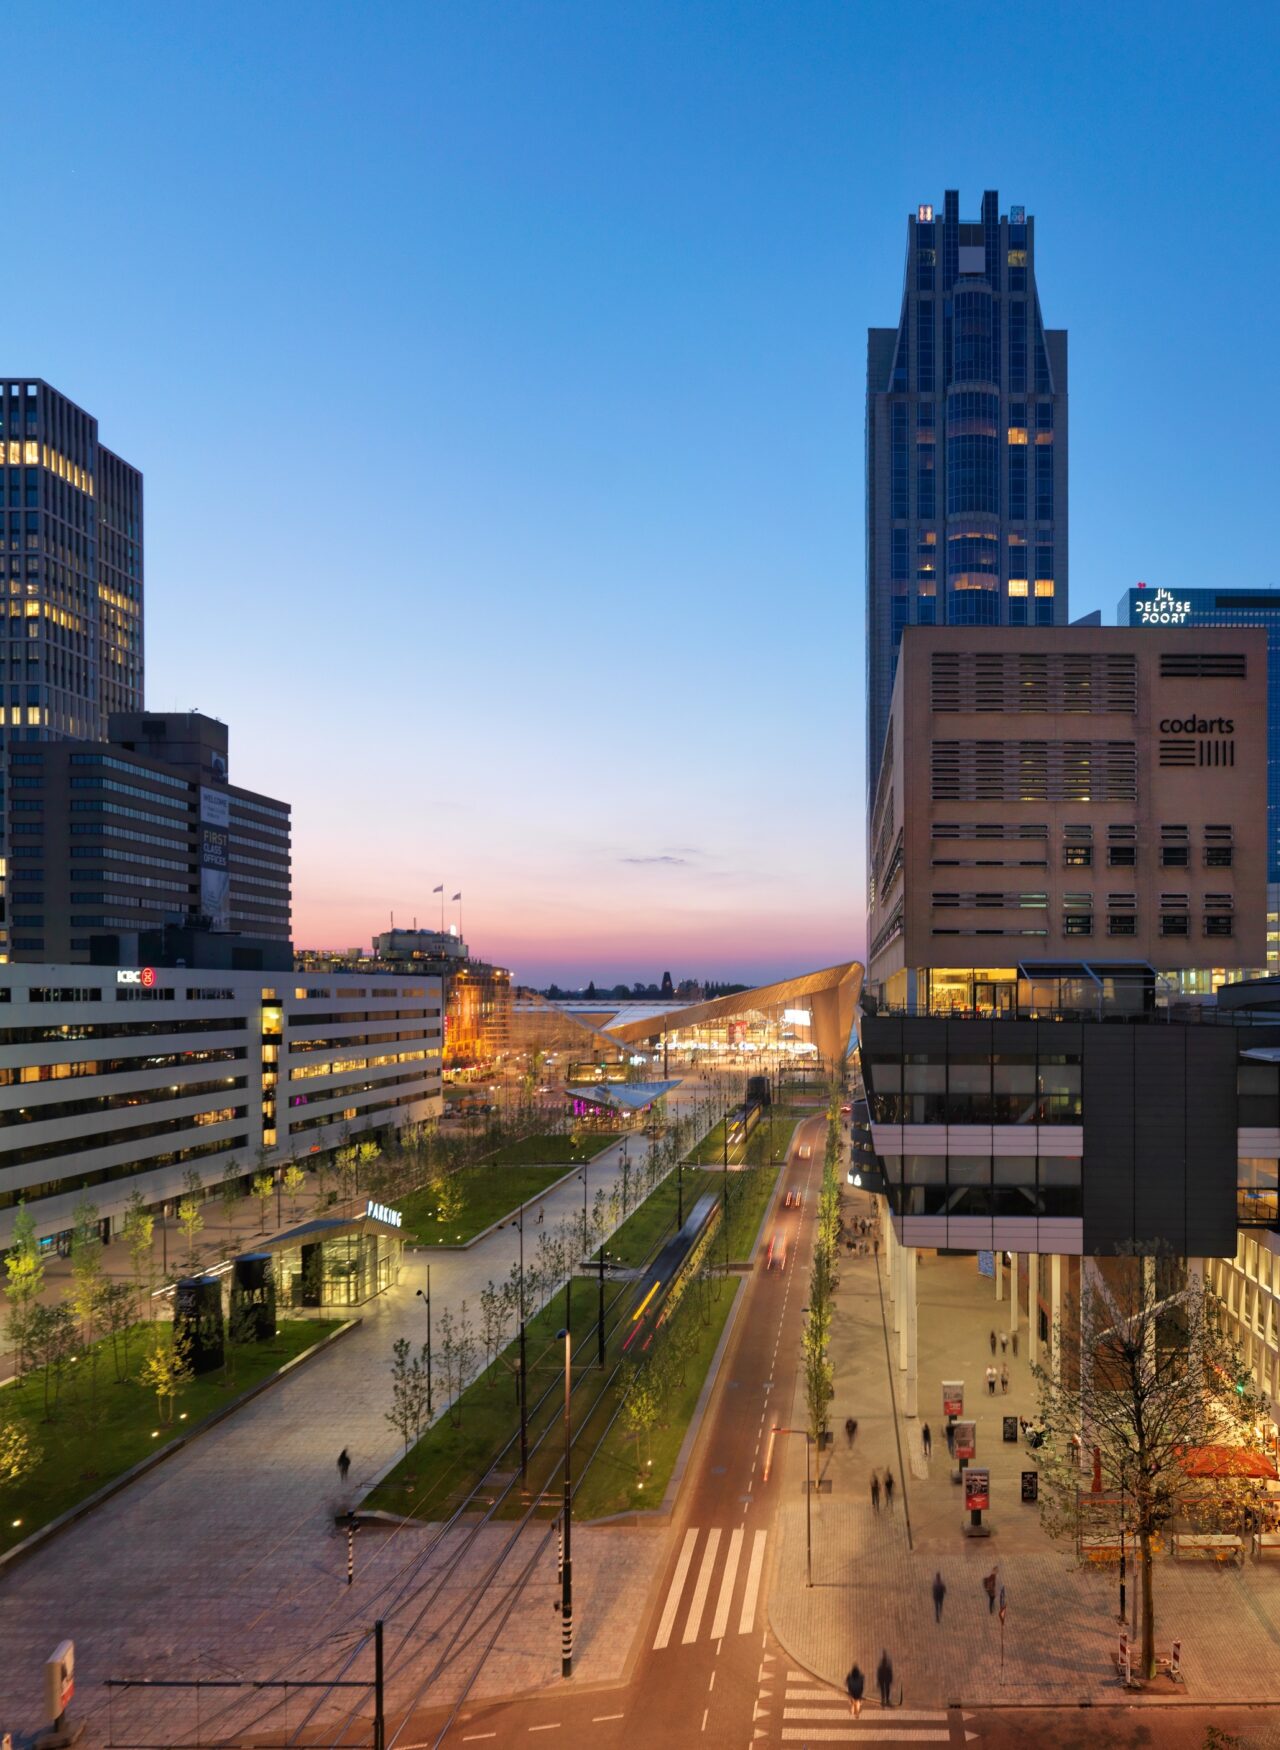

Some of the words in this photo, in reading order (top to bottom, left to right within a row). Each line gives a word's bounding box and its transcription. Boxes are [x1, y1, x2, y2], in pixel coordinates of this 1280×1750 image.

[1136, 601, 1191, 612] DELFTSE
[1142, 613, 1186, 623] POORT
[1159, 714, 1234, 734] codarts
[203, 831, 228, 846] FIRST
[203, 843, 222, 855] CLASS
[203, 854, 226, 866] OFFICES
[117, 970, 141, 983] ICBC
[367, 1200, 402, 1228] PARKING
